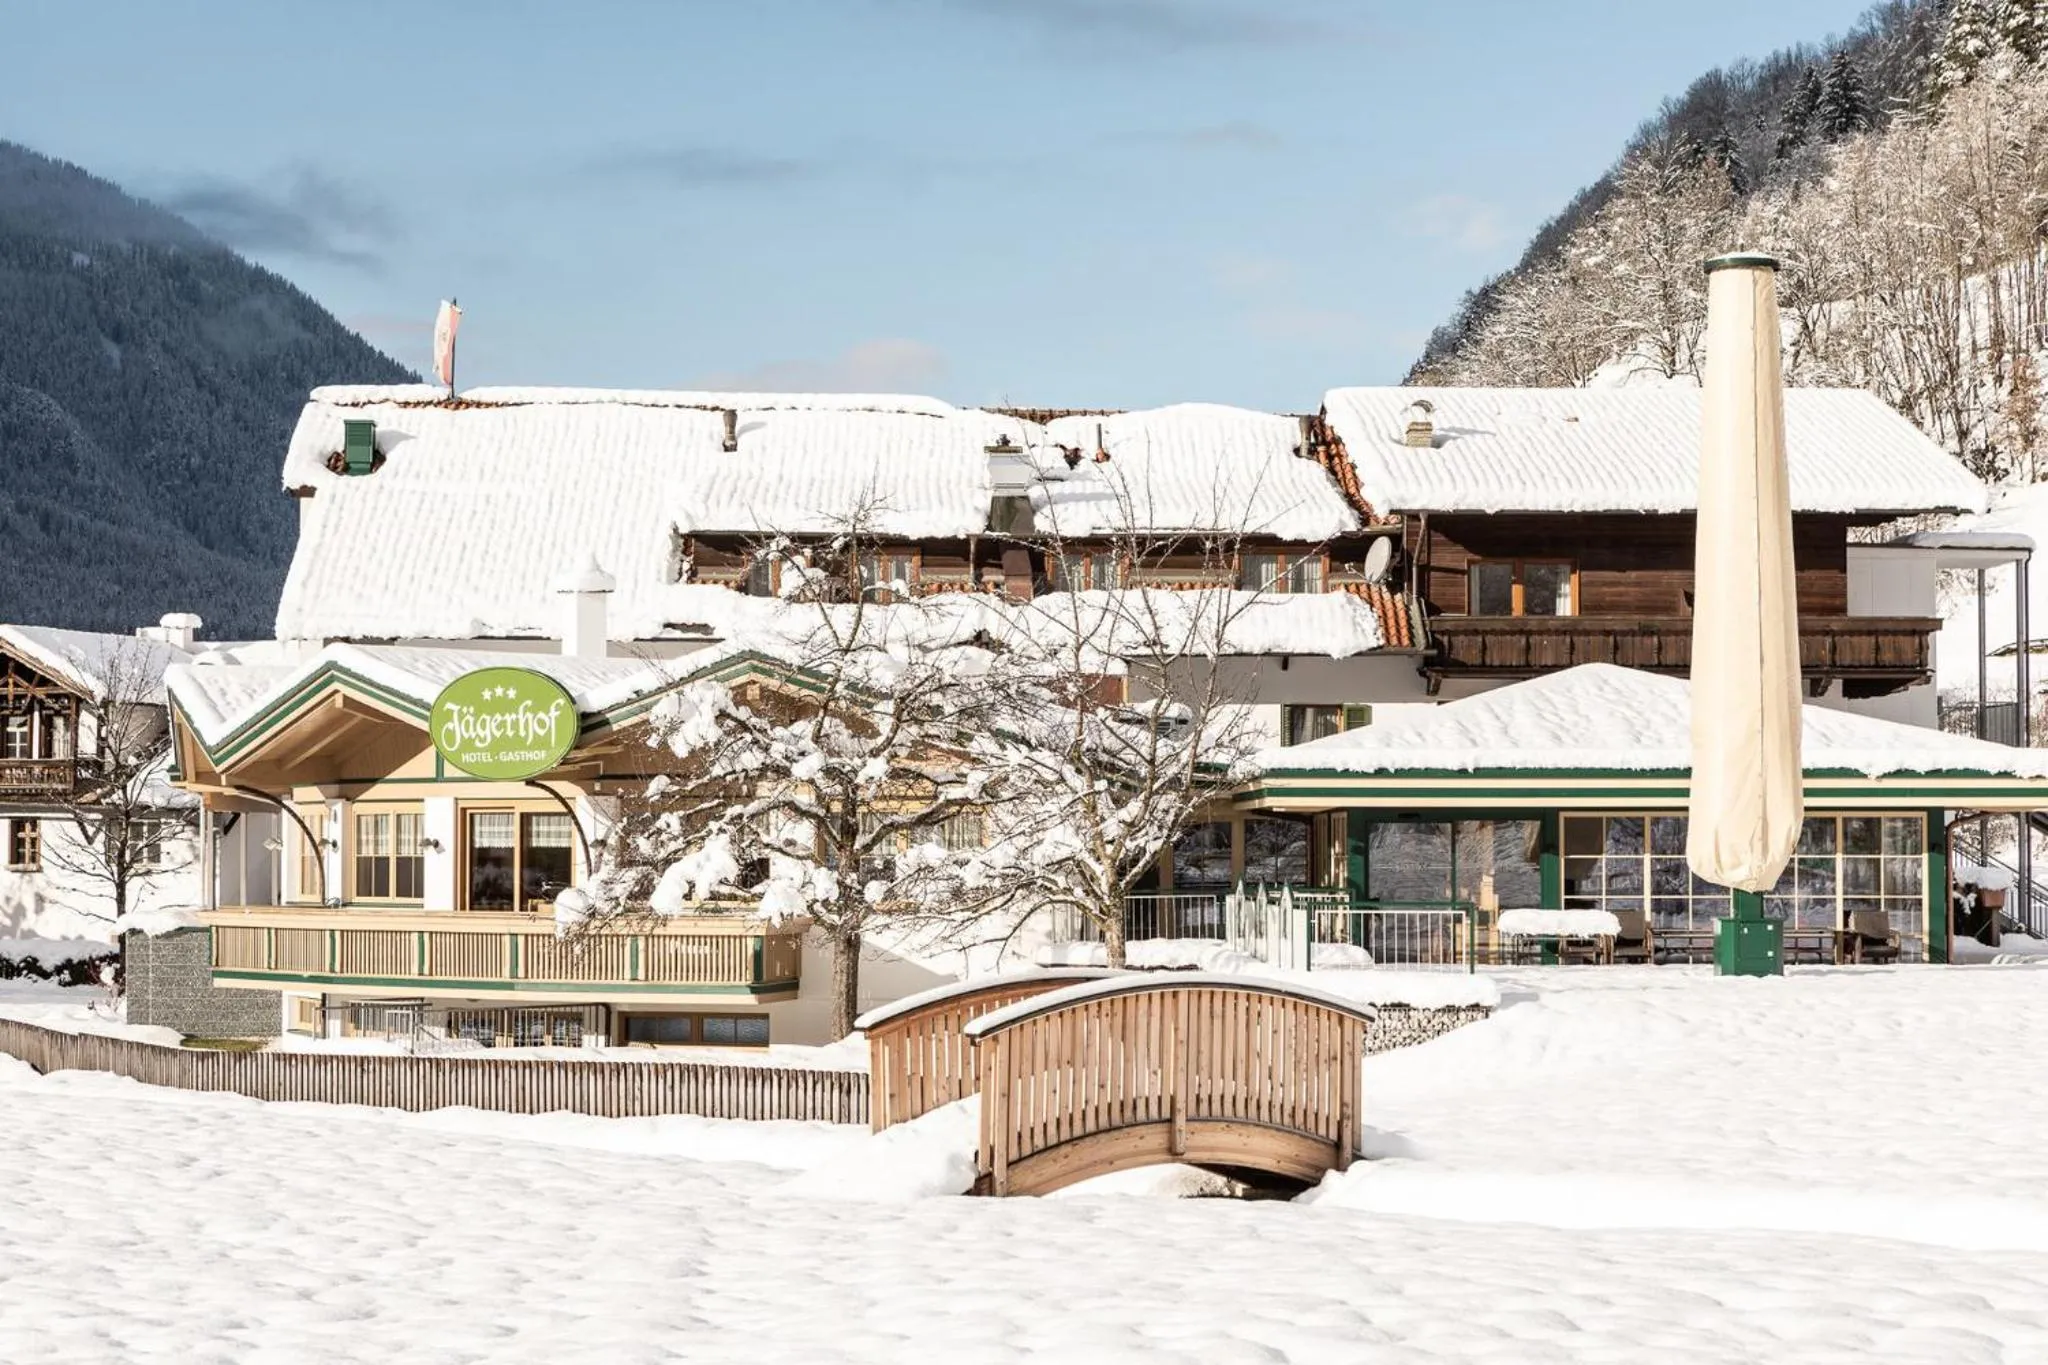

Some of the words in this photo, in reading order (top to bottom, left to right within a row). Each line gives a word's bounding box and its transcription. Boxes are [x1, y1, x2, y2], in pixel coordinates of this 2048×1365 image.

[441, 698, 565, 752] Jägerhof
[462, 751, 493, 763] HOTEL
[500, 750, 548, 762] GASTHOF
